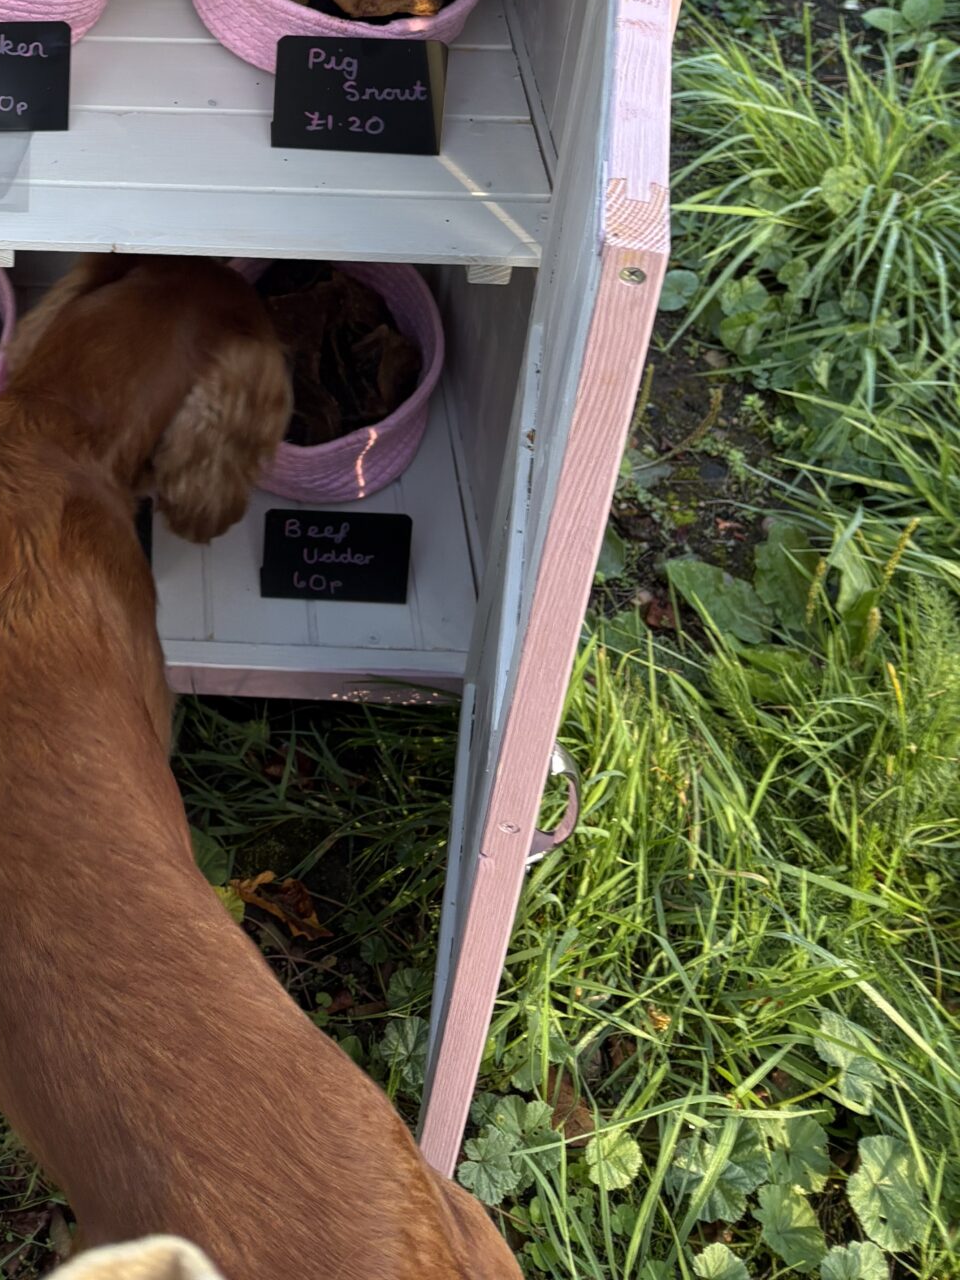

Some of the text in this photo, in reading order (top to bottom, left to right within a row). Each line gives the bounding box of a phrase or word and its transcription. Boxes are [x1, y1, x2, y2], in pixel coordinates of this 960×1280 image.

[308, 47, 358, 80] Pig
[343, 80, 427, 101] Snout
[284, 519, 350, 543] Beef
[303, 548, 375, 565] Udder
[293, 571, 343, 594] 60p
